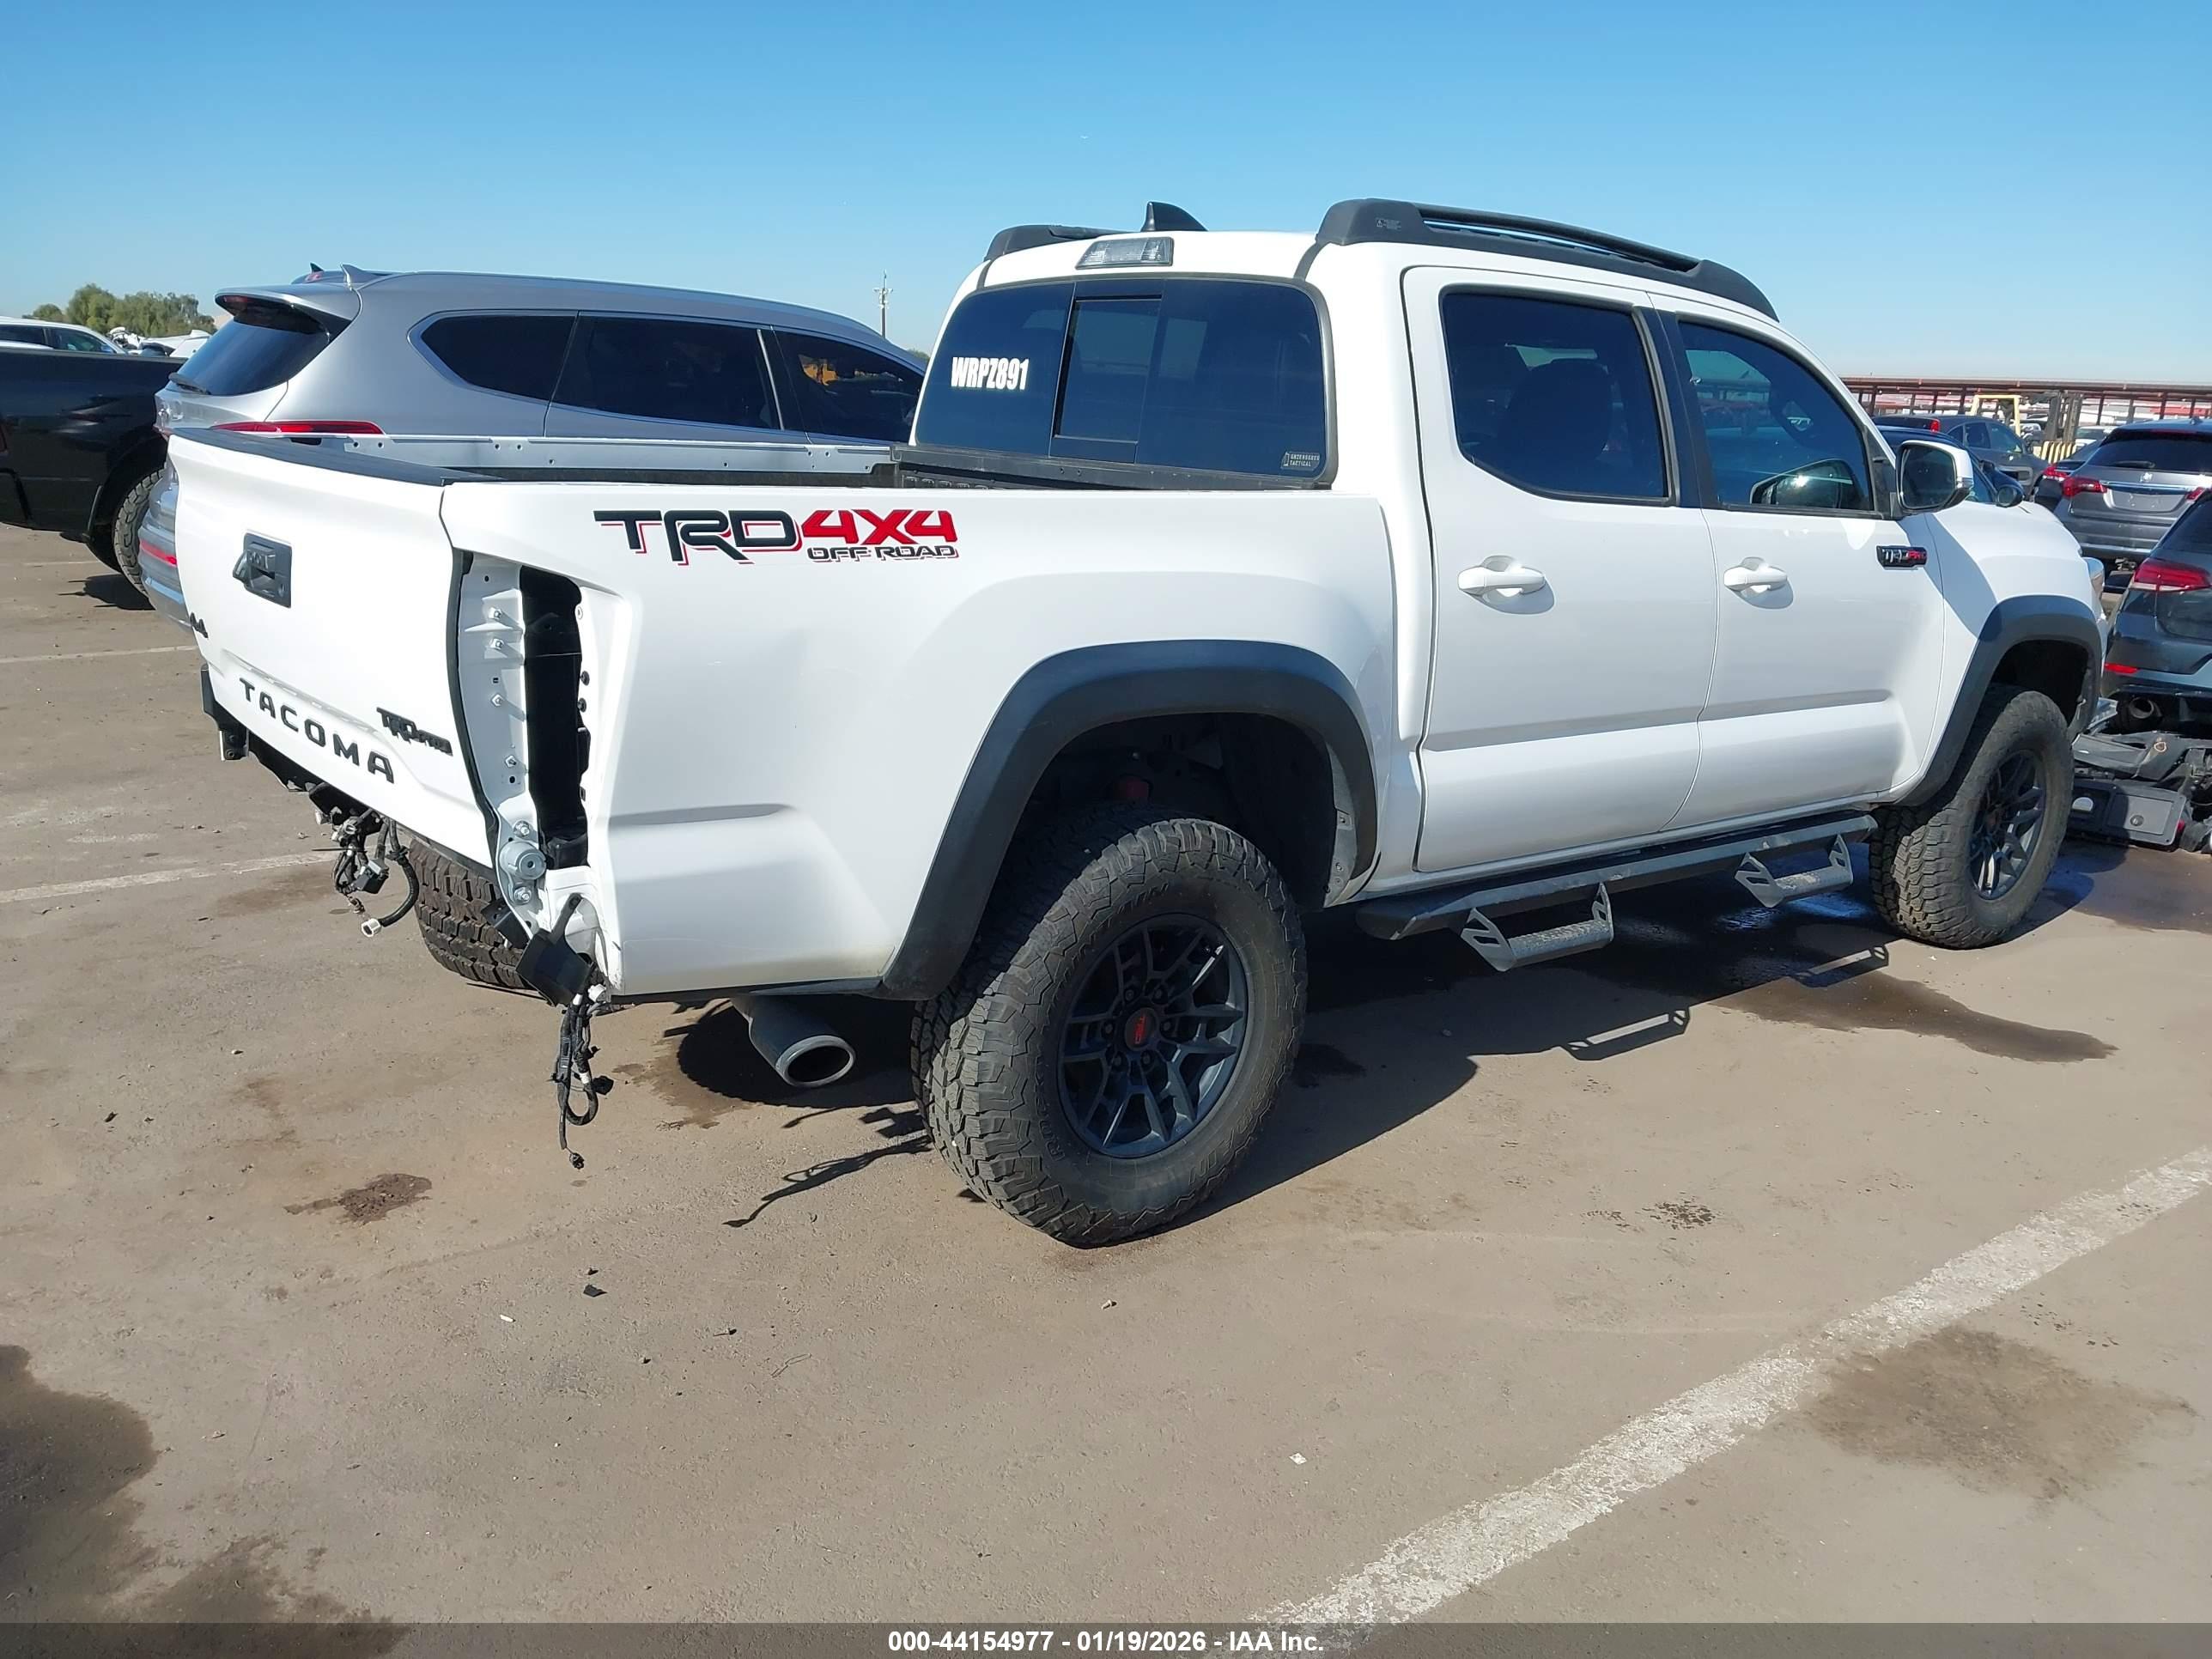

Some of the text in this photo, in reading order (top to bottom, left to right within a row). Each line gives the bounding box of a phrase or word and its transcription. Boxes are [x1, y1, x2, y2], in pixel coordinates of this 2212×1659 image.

[951, 356, 1030, 390] WRPZ891
[807, 545, 959, 562] OFF ROAD
[240, 678, 395, 784] TACOMA
